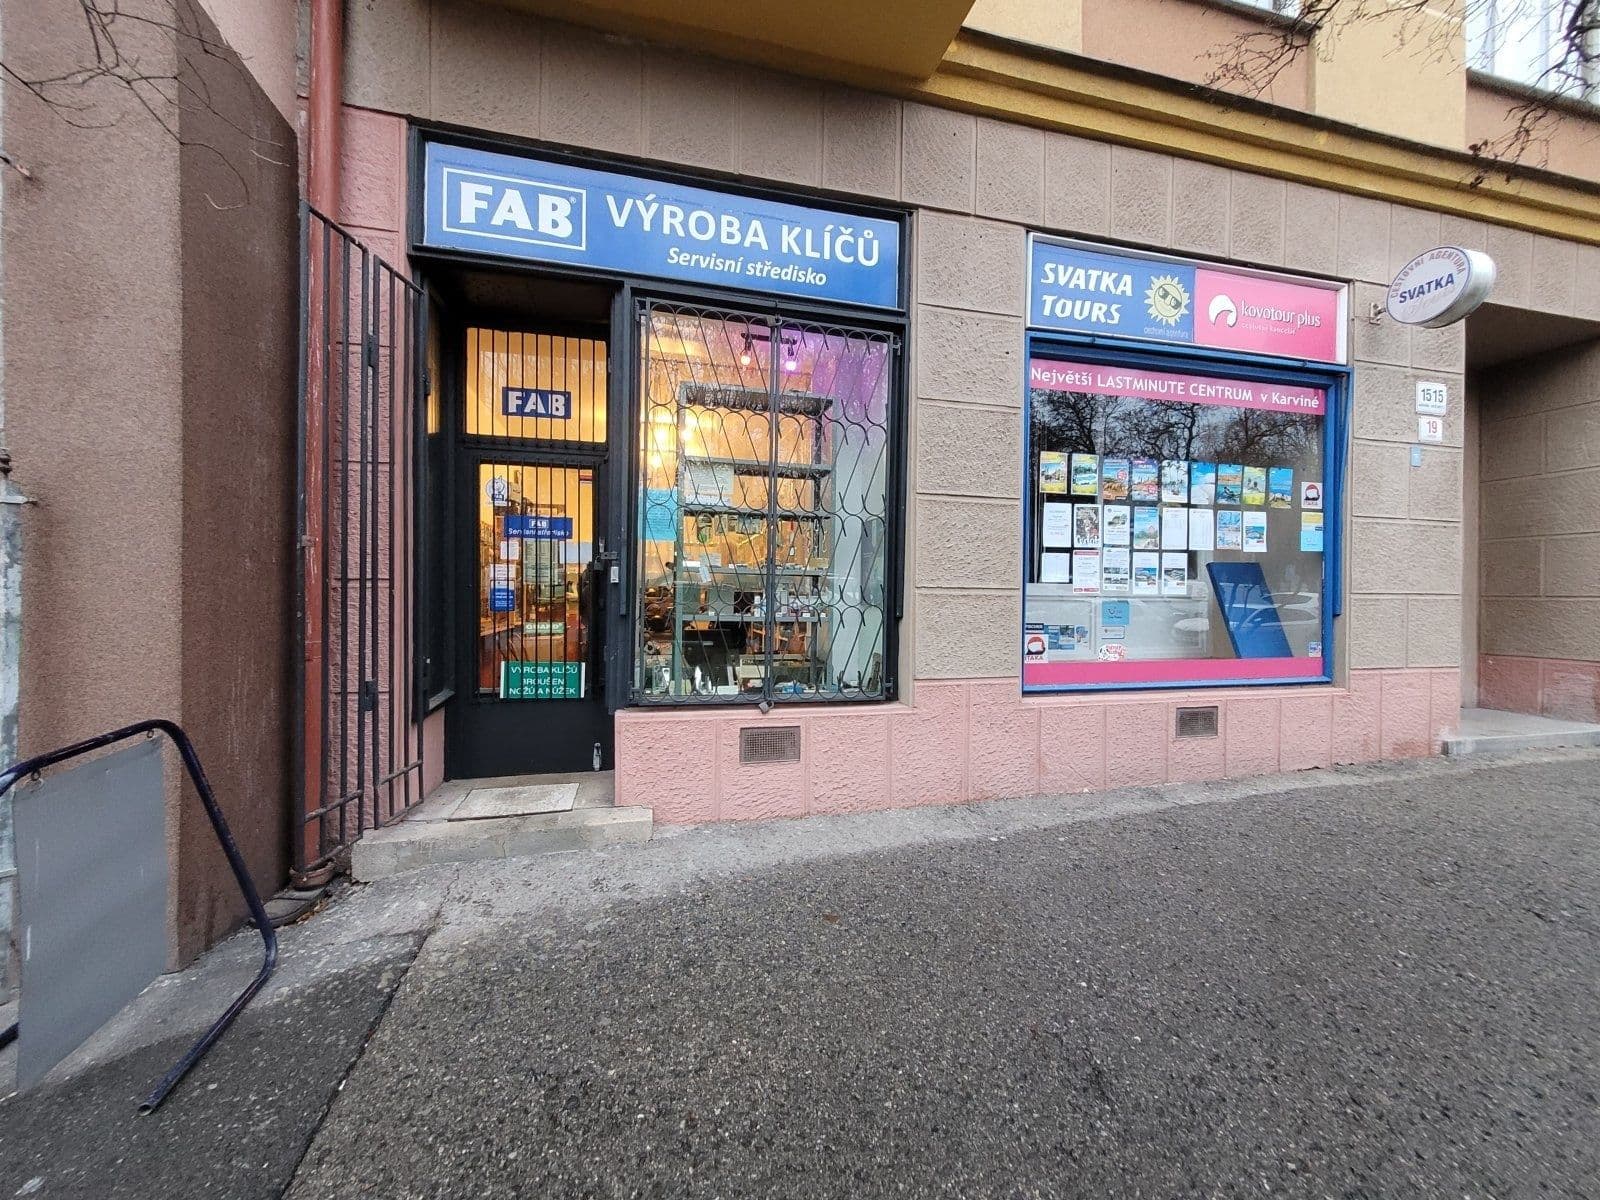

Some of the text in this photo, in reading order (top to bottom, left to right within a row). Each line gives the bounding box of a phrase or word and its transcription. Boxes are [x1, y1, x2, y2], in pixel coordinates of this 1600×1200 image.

[605, 193, 880, 268] VÝROBA KLÍČŮ
[667, 246, 828, 287] Servisní středisko
[1040, 262, 1133, 297] SVATKA
[1398, 272, 1456, 304] SVATKA
[1041, 295, 1122, 325] TOURS
[1241, 300, 1321, 329] kovotour plus
[1031, 367, 1320, 409] Největší LASTMINUTE CENTRUM v Karviné
[1420, 388, 1444, 403] 1515
[507, 391, 566, 417] FAB
[1426, 420, 1439, 434] 19
